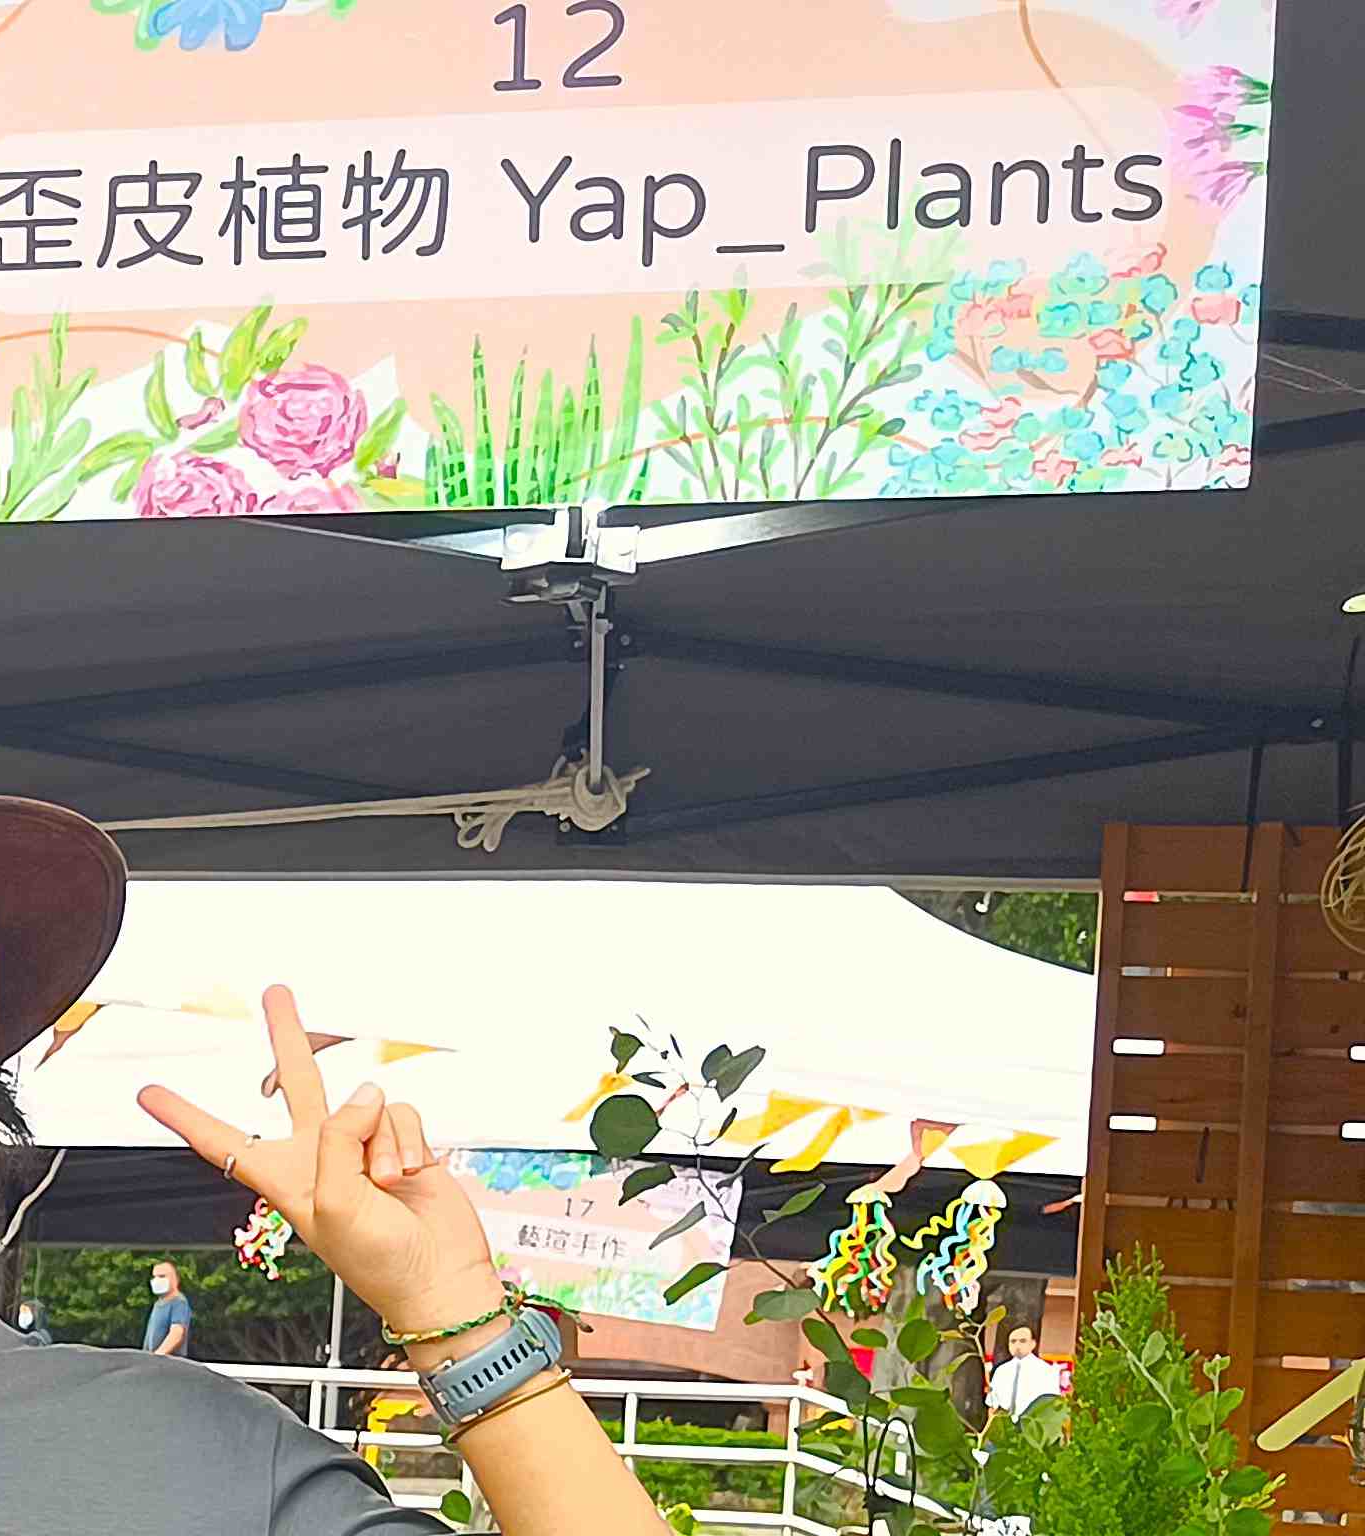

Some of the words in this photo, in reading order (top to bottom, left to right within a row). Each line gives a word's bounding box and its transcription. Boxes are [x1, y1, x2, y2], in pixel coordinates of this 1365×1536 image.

[493, 0, 624, 91] 12
[500, 138, 1163, 267] Yap_Plants
[564, 1197, 595, 1217] 17
